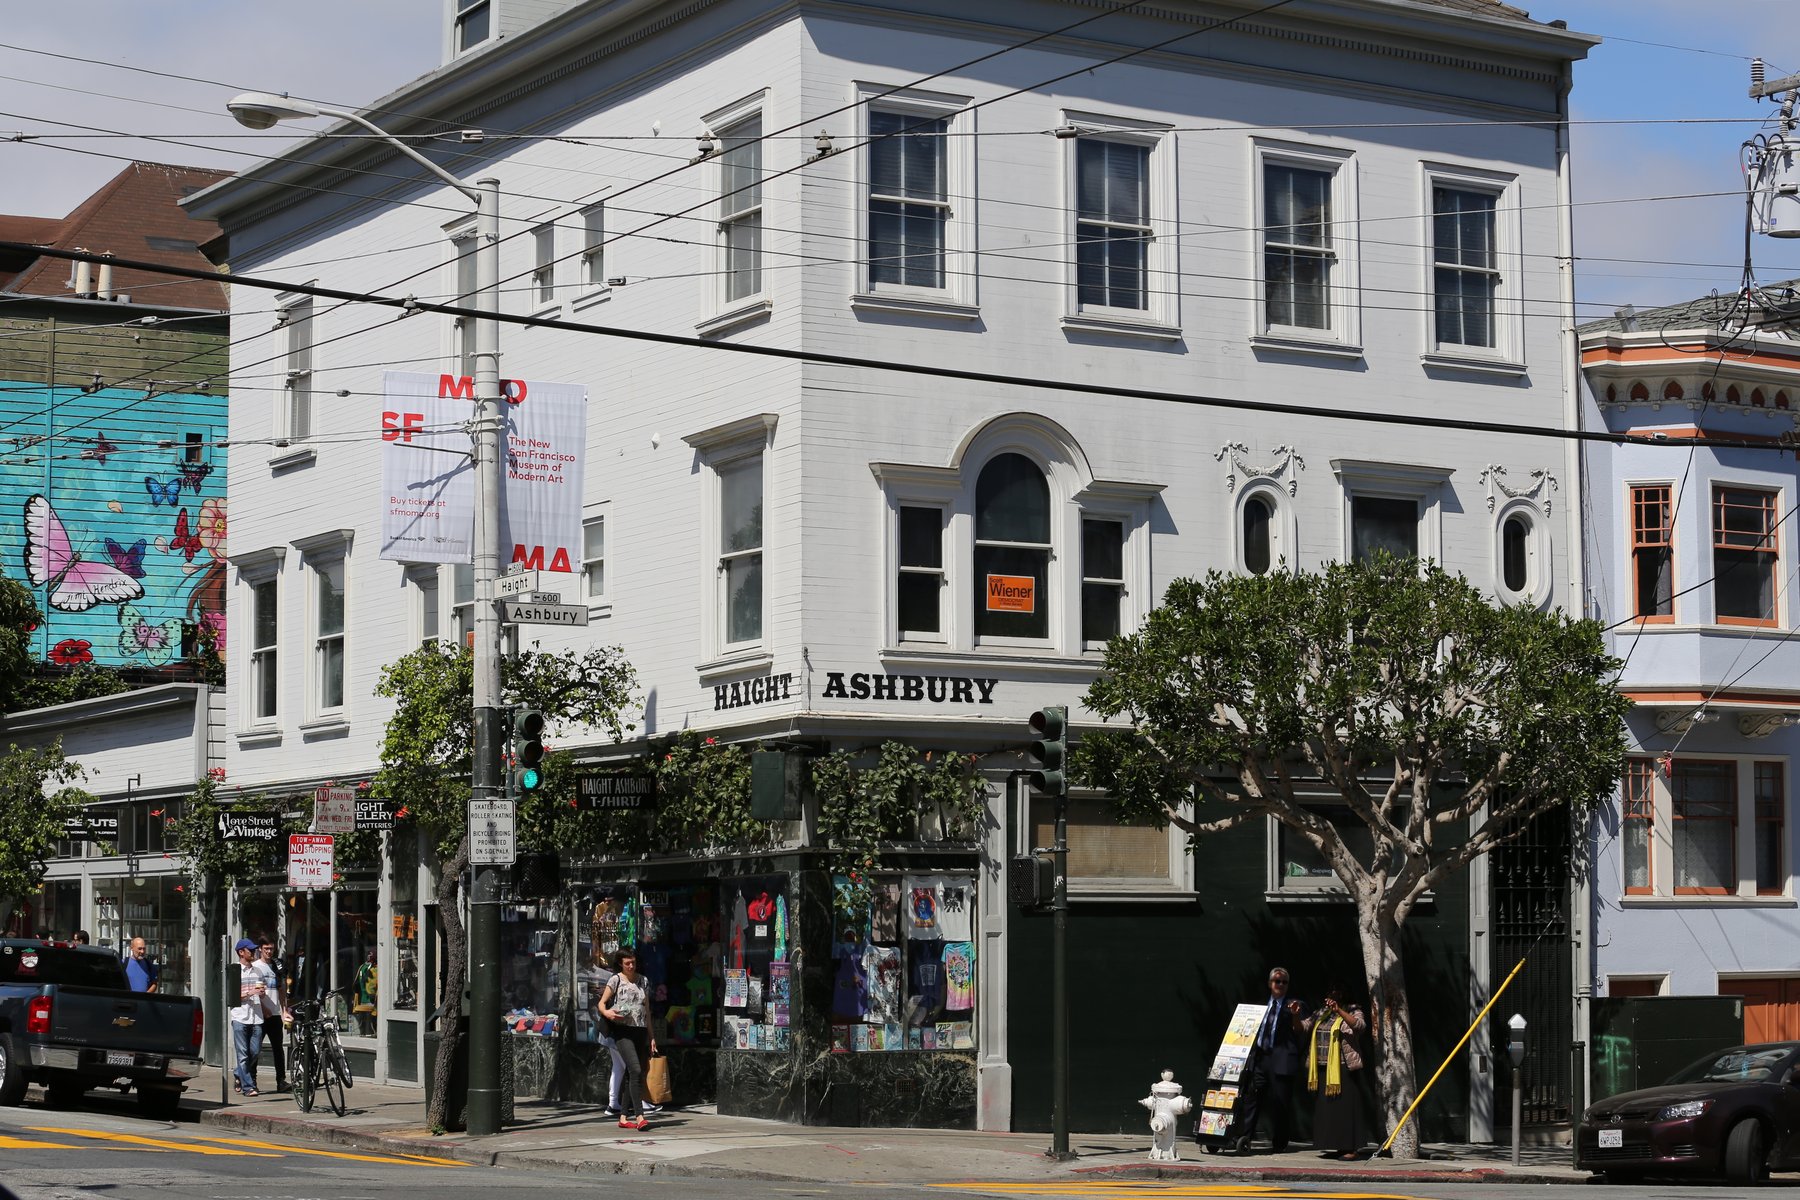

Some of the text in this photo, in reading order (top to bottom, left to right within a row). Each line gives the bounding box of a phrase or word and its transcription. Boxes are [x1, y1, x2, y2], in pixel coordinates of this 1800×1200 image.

[382, 411, 424, 442] SF
[509, 437, 551, 449] The New
[509, 448, 576, 462] San Francisco
[509, 459, 563, 472] Museum of
[509, 471, 564, 483] Modern Art
[390, 496, 406, 505] Buy
[408, 498, 435, 506] tickets
[390, 508, 440, 519] sfmoma.org
[512, 544, 572, 573] MA
[93, 578, 128, 594] Hendrix
[501, 577, 528, 593] Haight
[989, 583, 1033, 598] Wiener
[542, 594, 558, 602] 600
[513, 607, 578, 624] Ashbury
[713, 671, 999, 711] HAIGHT ASHBURY
[581, 777, 652, 795] HAIGHT ASHBURY
[318, 788, 353, 801] NO PARKING
[590, 796, 642, 807] T-SHIRTS
[224, 812, 274, 826] Love Street
[234, 825, 278, 840] Vintage
[296, 836, 327, 844] TOW-AWAY
[291, 843, 332, 854] NO STOPPING
[301, 858, 320, 866] ANY
[300, 867, 321, 876] TIME
[642, 892, 667, 905] OPEN
